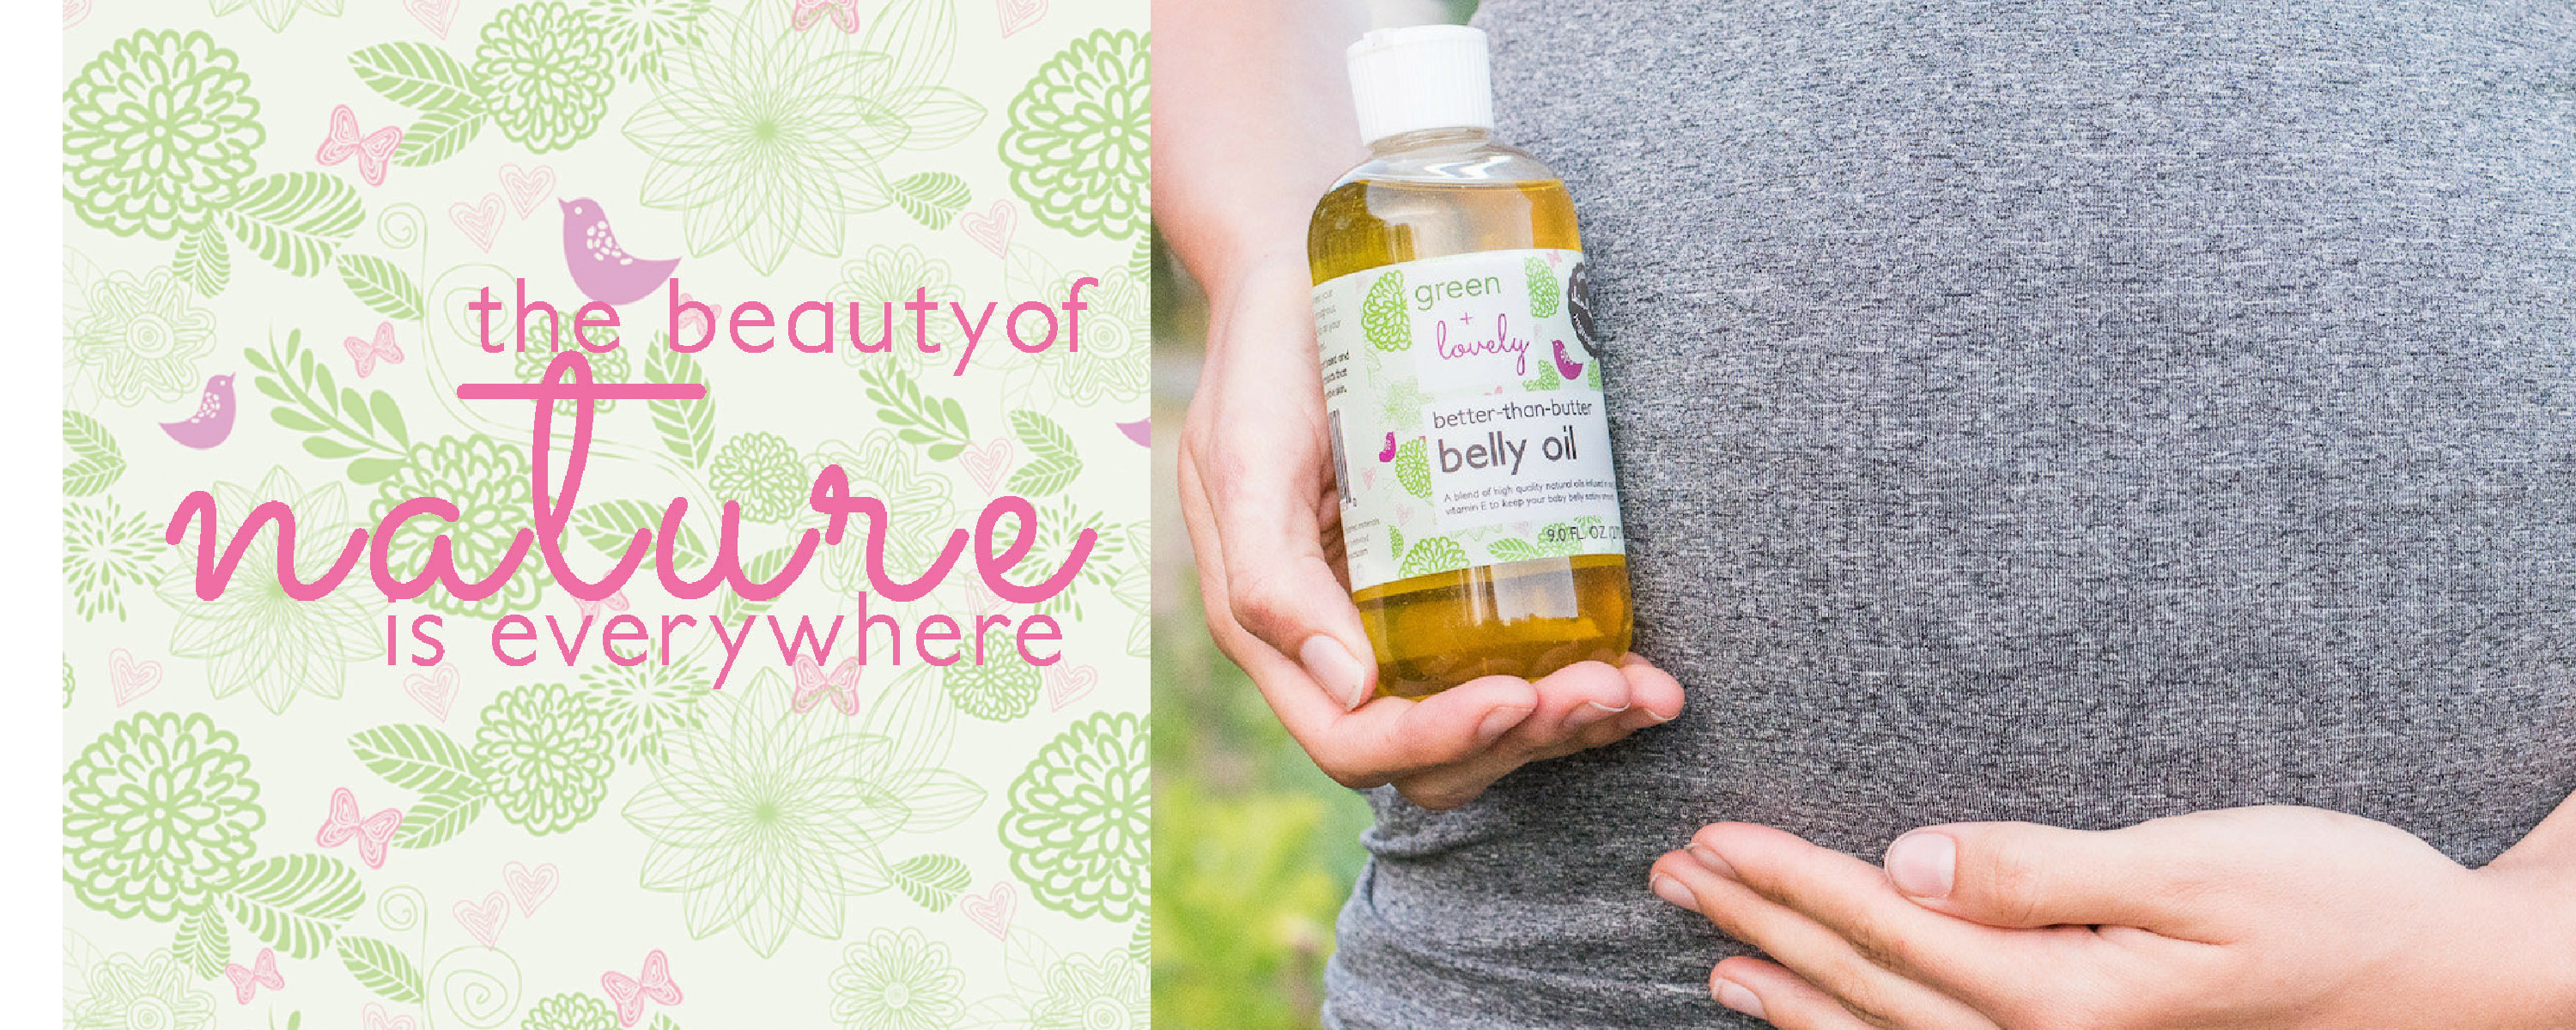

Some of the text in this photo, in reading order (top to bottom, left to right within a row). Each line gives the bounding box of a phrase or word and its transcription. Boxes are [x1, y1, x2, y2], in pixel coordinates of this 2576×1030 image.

[1415, 276, 1501, 311] green
[1437, 313, 1529, 376] lovely
[1433, 399, 1593, 428] better-than-butter
[1438, 425, 1577, 476] belly oil
[1444, 494, 1451, 503] A
[1454, 489, 1479, 501] blend
[1482, 487, 1492, 498] of
[1494, 485, 1513, 497] high
[1516, 482, 1543, 494] quality
[1546, 479, 1572, 490] natural
[1445, 503, 1479, 515] vitamin
[1481, 501, 1487, 511] E
[1490, 501, 1499, 510] to
[1502, 498, 1524, 508] keep
[1526, 496, 1546, 507] your
[1548, 493, 1566, 504] baby
[1568, 491, 1584, 503] belly
[1546, 527, 1566, 542] 9.0
